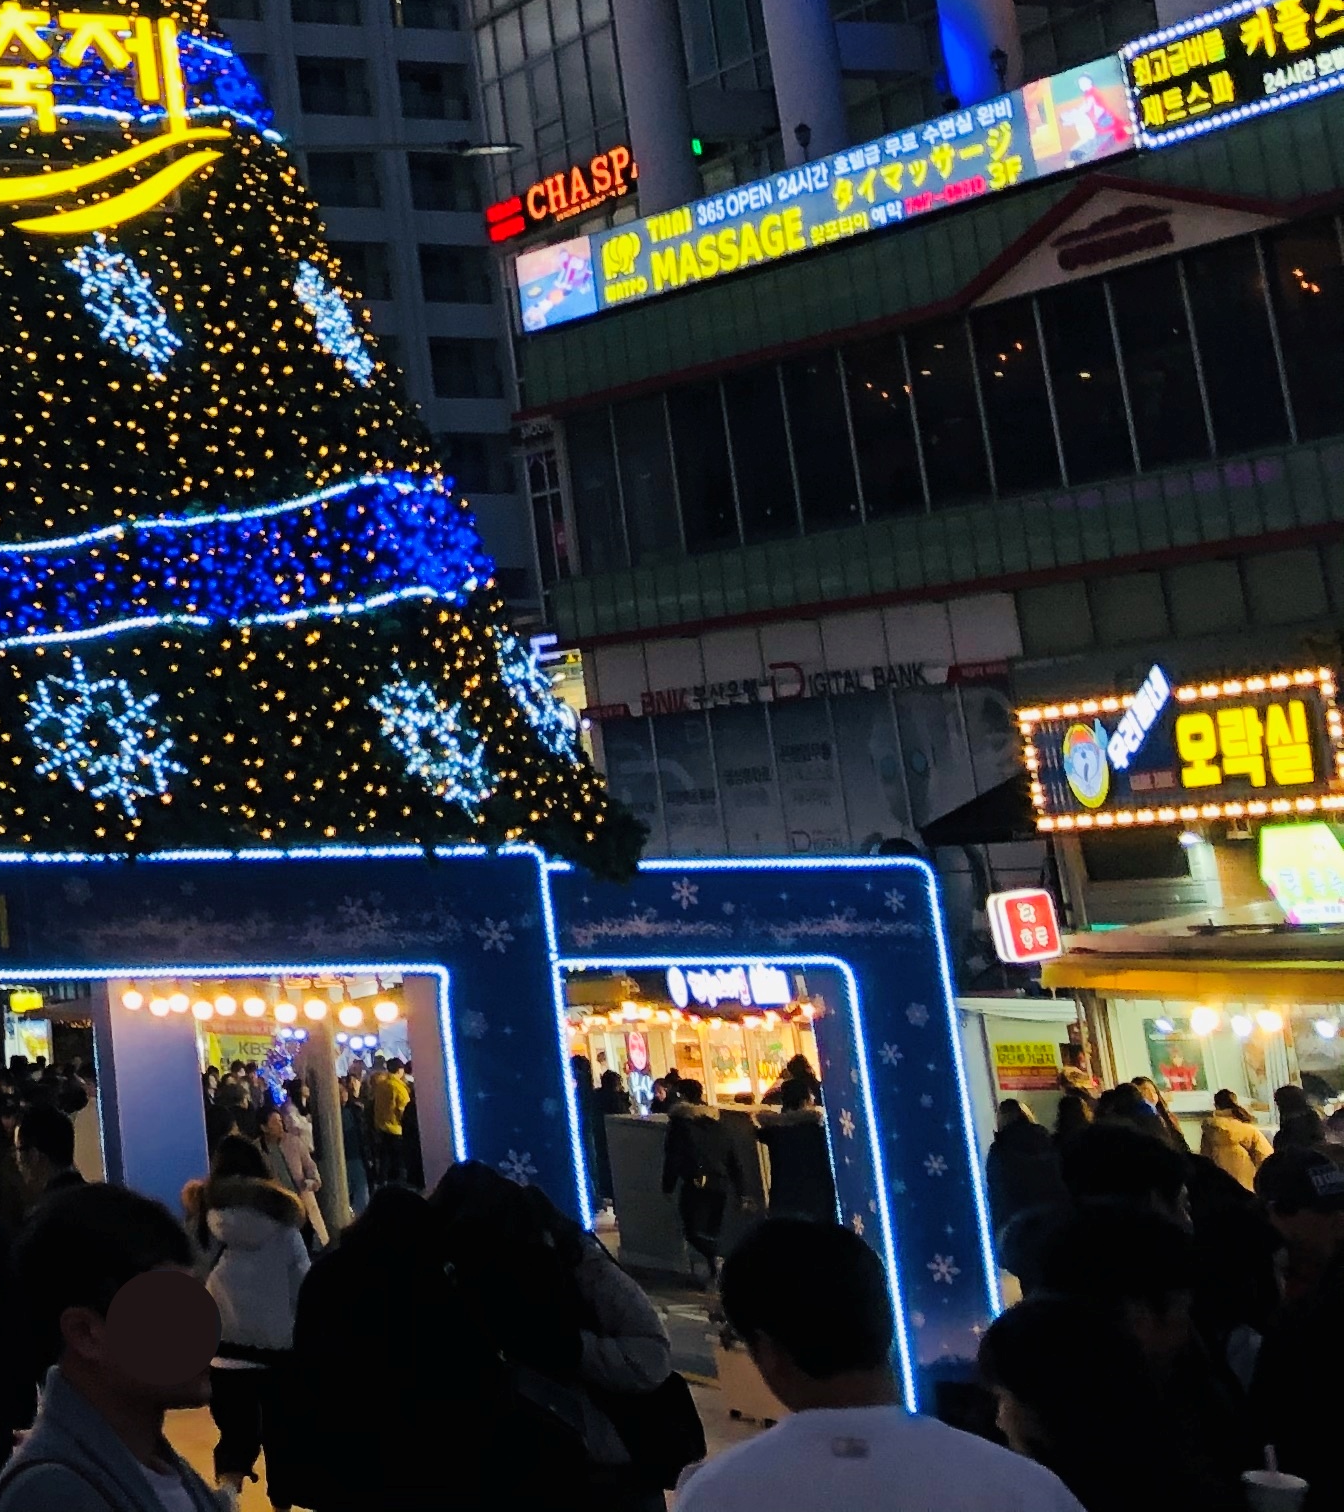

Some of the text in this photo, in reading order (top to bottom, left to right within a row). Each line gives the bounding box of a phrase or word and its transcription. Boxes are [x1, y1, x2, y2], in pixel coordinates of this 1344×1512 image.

[1141, 70, 1234, 127] 제트스파
[1263, 58, 1316, 94] 24시간
[697, 203, 724, 226] 365
[727, 184, 773, 218] OPEN
[777, 162, 829, 201] 24시간
[884, 132, 920, 159] 무료
[833, 121, 1012, 212] タイマッサージ
[988, 155, 1023, 190] 3F
[646, 206, 692, 243] THAI
[870, 199, 904, 226] 예약
[650, 206, 805, 291] MASSAGE
[872, 662, 929, 689] BANK
[1176, 699, 1315, 789] 오락실
